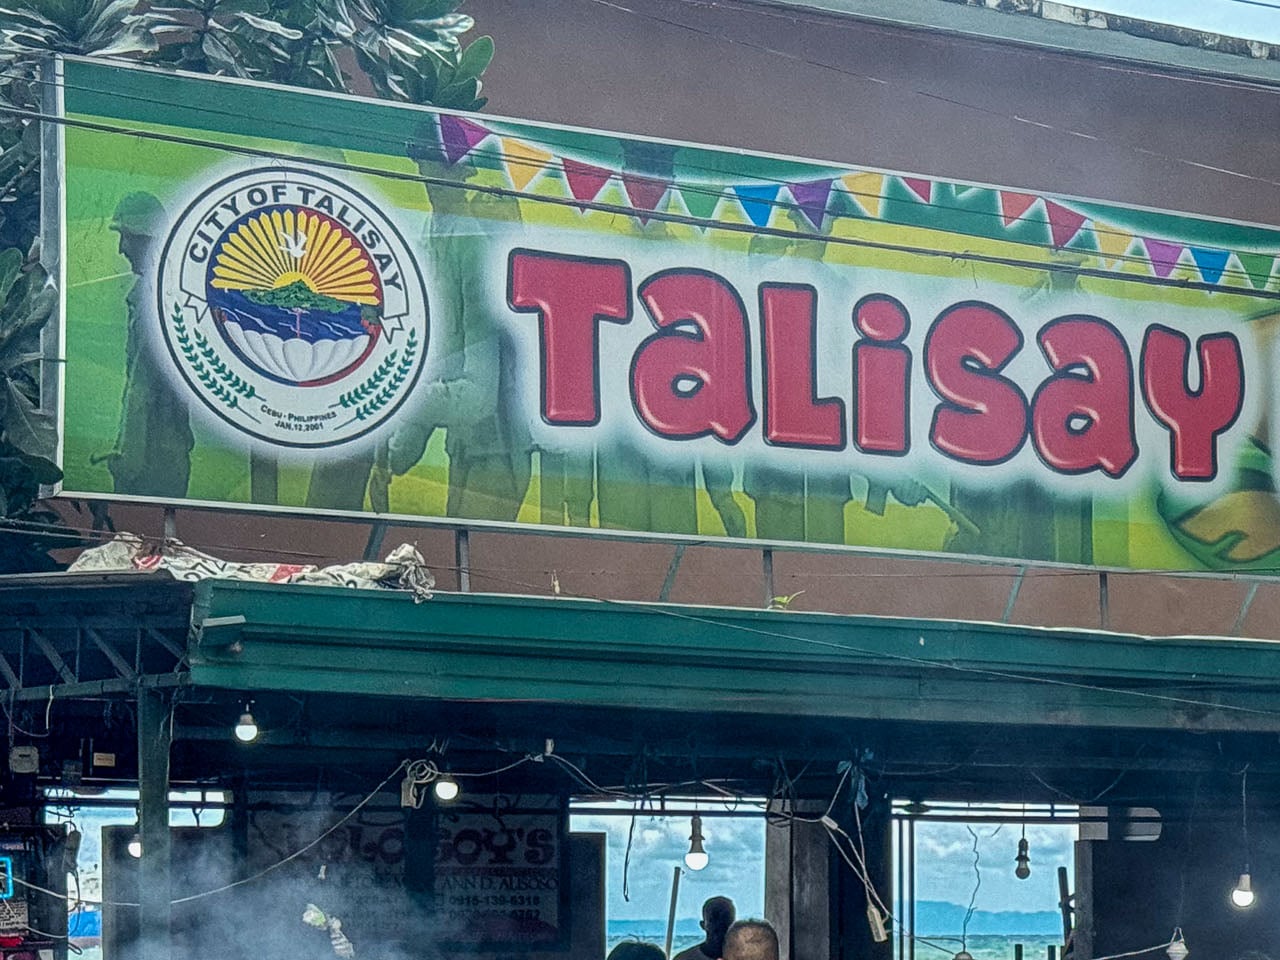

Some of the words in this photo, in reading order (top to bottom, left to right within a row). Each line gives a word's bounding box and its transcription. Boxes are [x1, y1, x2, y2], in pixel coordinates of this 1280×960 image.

[189, 192, 241, 264] CITY
[246, 185, 287, 205] OF
[297, 186, 402, 291] TALISAY
